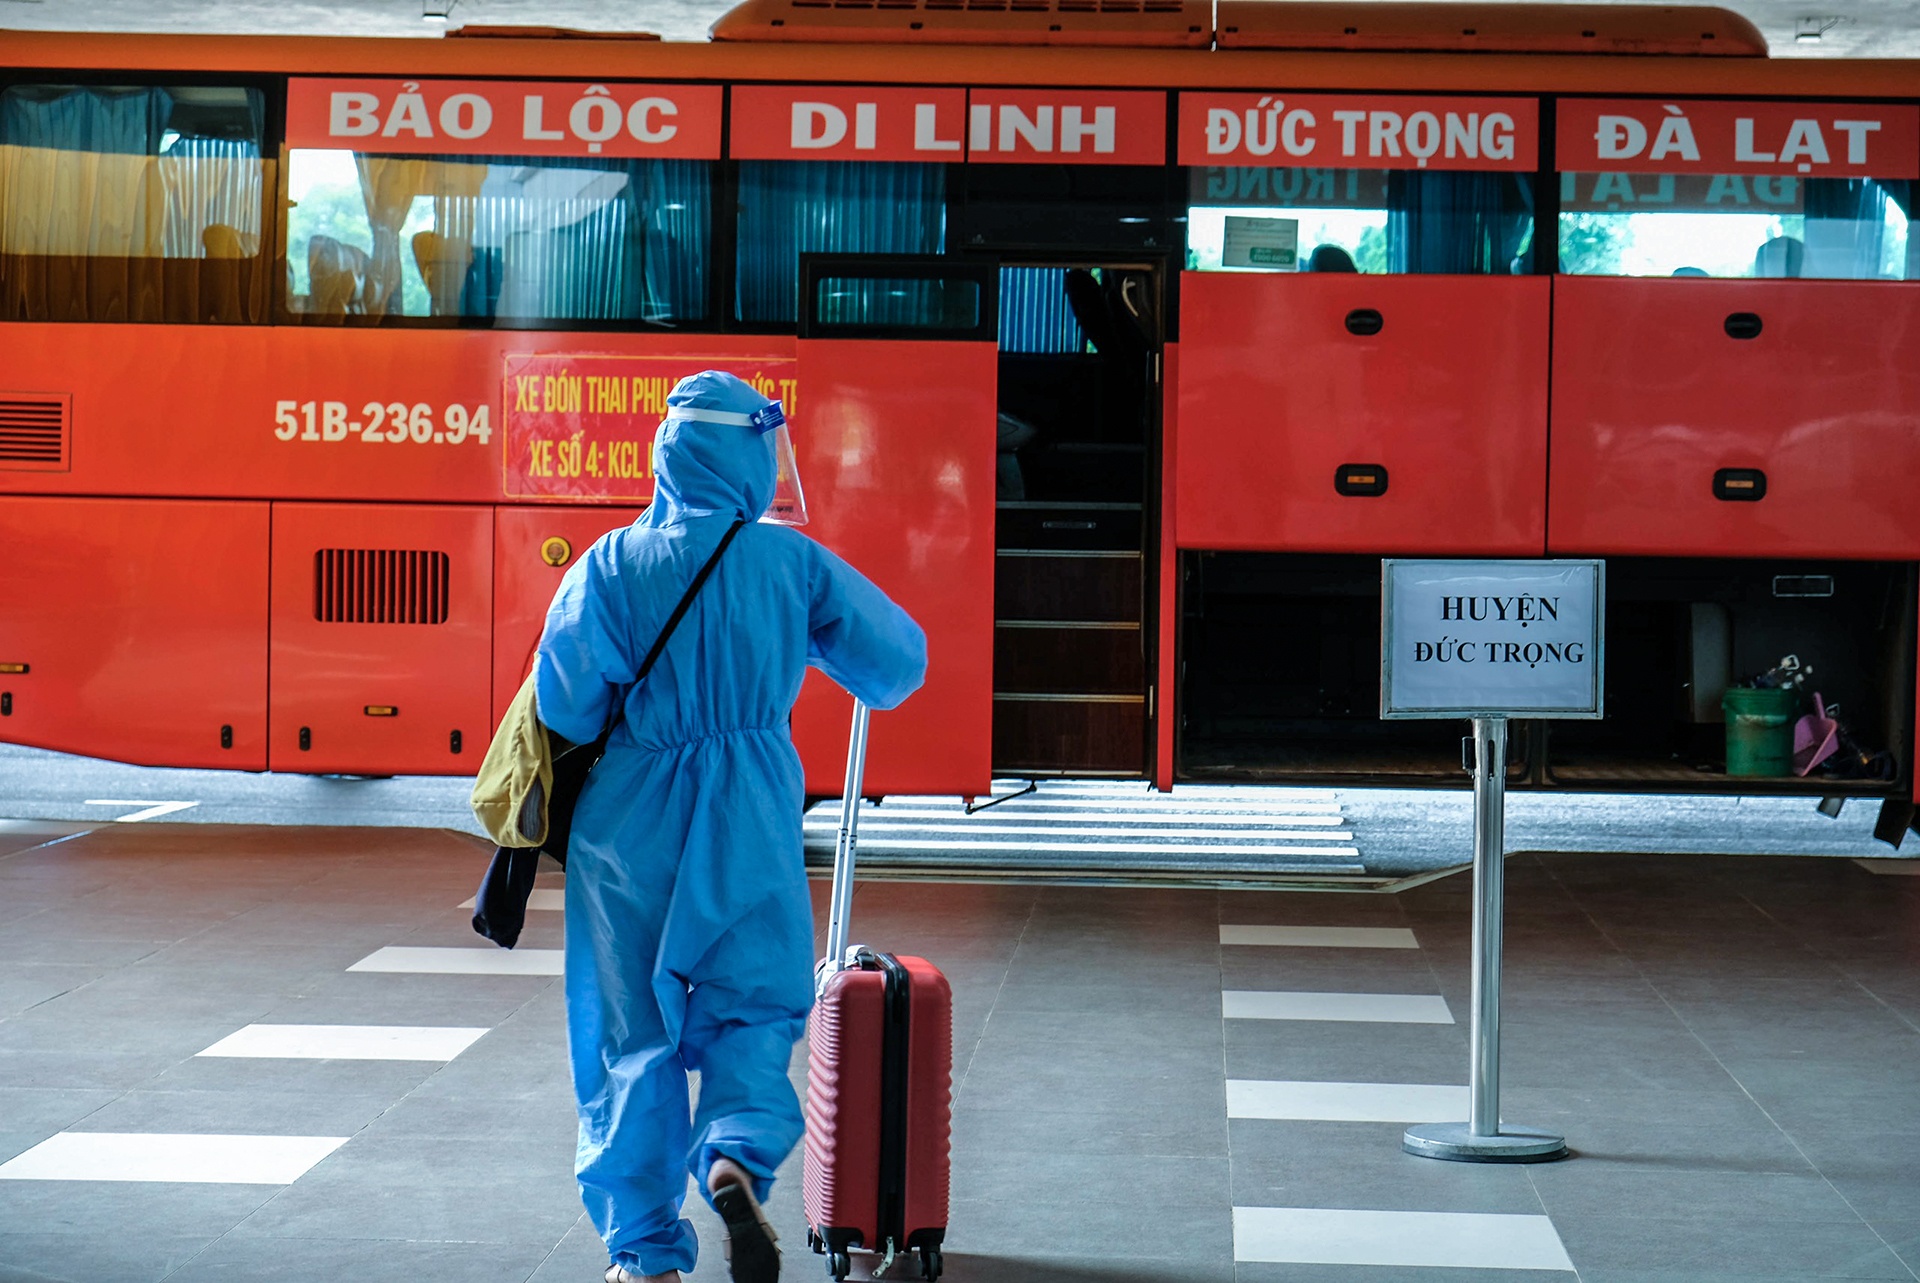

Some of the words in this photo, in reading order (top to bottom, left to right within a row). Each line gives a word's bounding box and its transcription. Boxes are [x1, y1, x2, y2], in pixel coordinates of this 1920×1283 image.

[329, 81, 493, 139] BẢO
[522, 84, 678, 153] LỘC
[790, 102, 877, 150] DI
[914, 103, 1116, 153] LINH
[1205, 97, 1316, 157] ĐỨC
[1333, 110, 1515, 168] TRỌNG
[1594, 105, 1701, 161] ĐÀ
[1735, 118, 1881, 172] LẠT
[515, 375, 541, 413] XE
[543, 368, 583, 413] ĐÓN
[586, 376, 628, 414] THAI
[274, 400, 493, 445] 51B-236.94
[529, 440, 554, 478] XE
[557, 430, 585, 478] SỐ
[585, 441, 604, 478] 4:
[608, 441, 643, 479] KCL
[1440, 593, 1560, 628] HUYỆN
[1414, 636, 1476, 663] ĐỨC
[1484, 642, 1584, 669] TRỌNG
